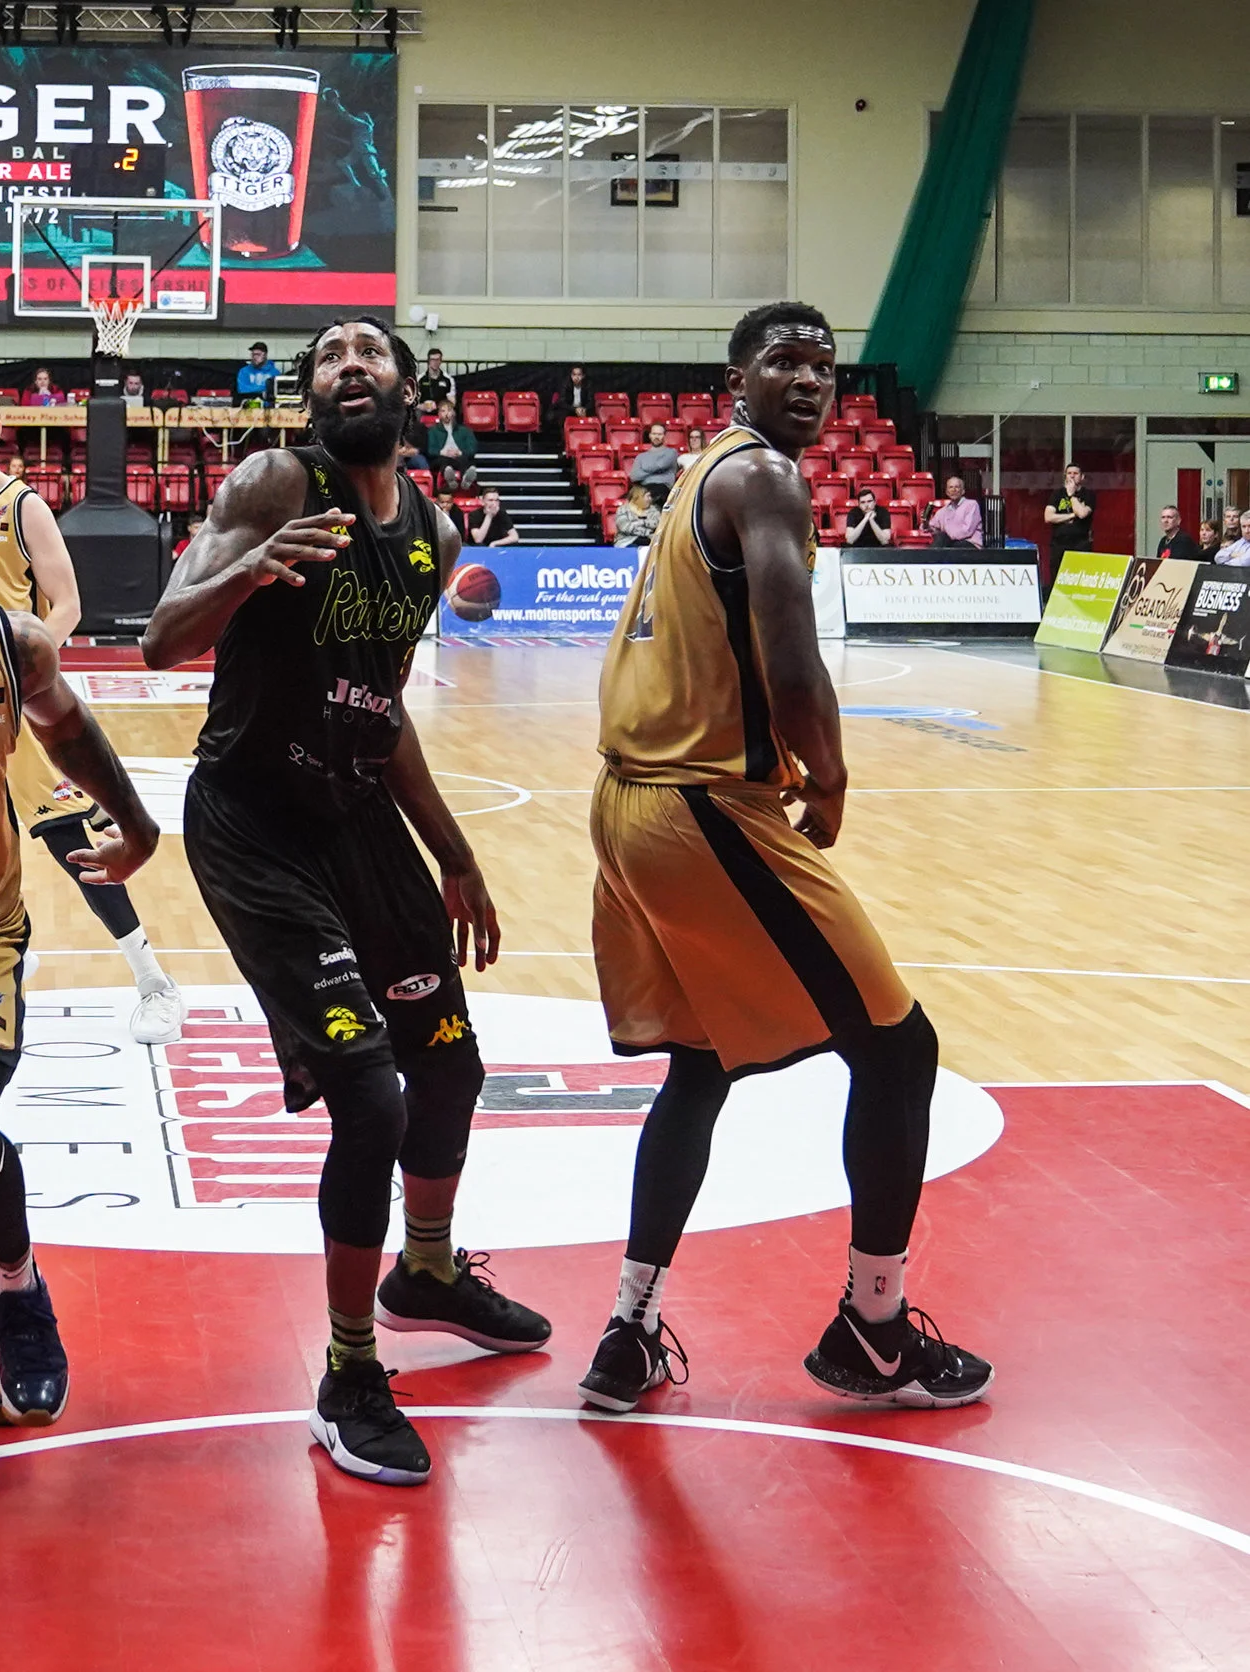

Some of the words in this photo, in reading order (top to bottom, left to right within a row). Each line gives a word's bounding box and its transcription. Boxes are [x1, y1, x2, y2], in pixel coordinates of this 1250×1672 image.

[13, 147, 66, 160] BAL
[28, 163, 72, 180] ALE
[220, 175, 284, 196] TIGER
[5, 207, 59, 224] 172
[537, 564, 633, 588] molten
[847, 567, 914, 587] CASA
[922, 567, 1035, 587] ROMANA
[555, 591, 574, 603] the
[1195, 589, 1243, 612] BUSINESS
[492, 607, 620, 622] www.moltensports.co
[313, 973, 350, 990] edward
